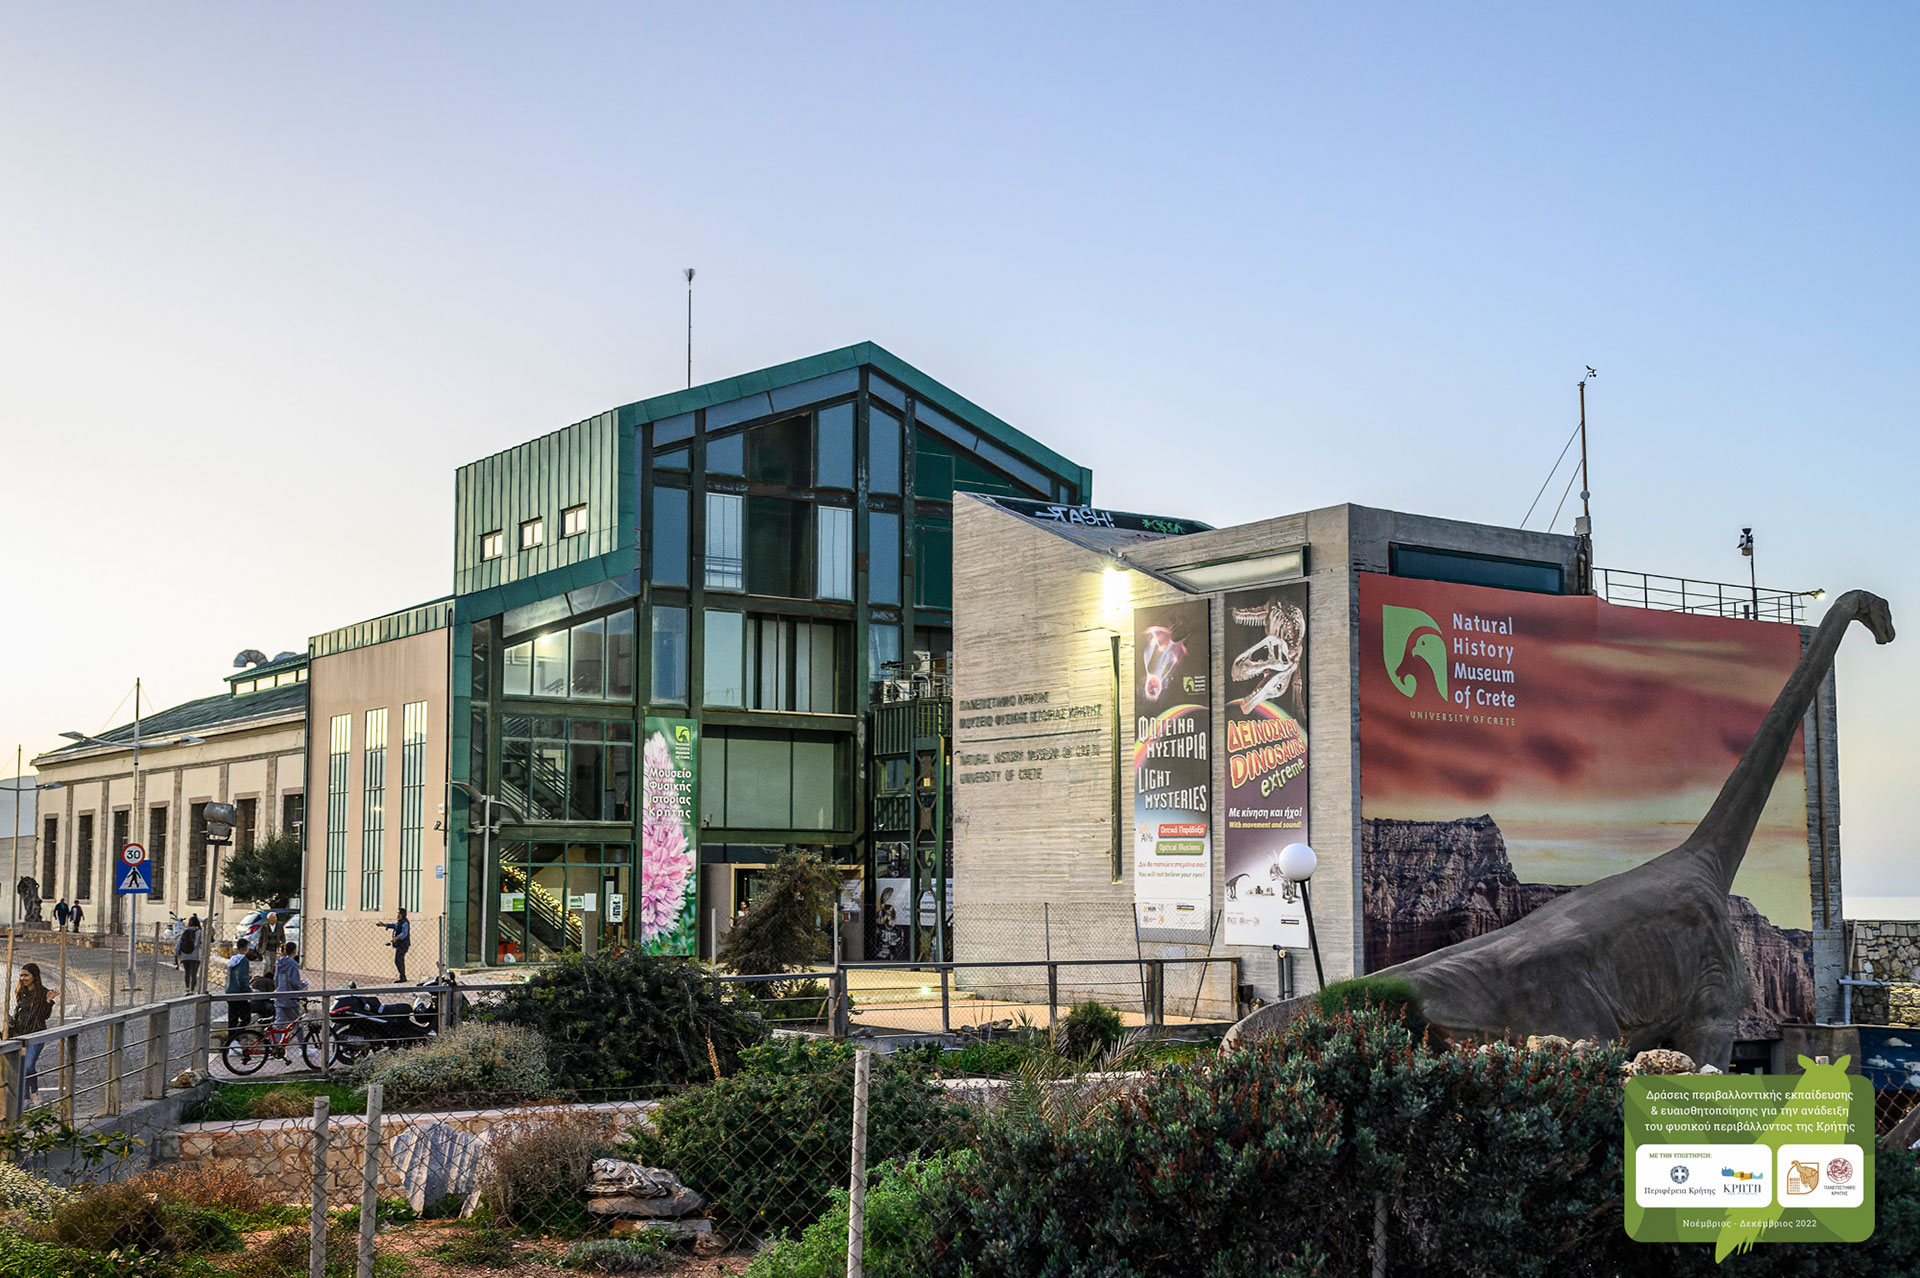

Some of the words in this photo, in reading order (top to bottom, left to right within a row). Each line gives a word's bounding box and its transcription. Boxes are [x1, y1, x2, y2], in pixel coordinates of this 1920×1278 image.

[1453, 613, 1513, 635] Natural
[1453, 637, 1514, 664] History
[1454, 662, 1515, 683] Museum
[1455, 685, 1471, 710] of
[1476, 689, 1516, 708] Crete
[1409, 710, 1471, 723] UNIVERSITY
[1473, 715, 1485, 724] OF
[1487, 716, 1516, 726] CRETE
[1146, 731, 1207, 761] ΜΥΣΤΗΡΙΑ
[650, 767, 692, 779] Μουσείο
[1230, 738, 1306, 789] DINOSAURS
[649, 780, 692, 793] Φυσικής
[1138, 766, 1172, 794] LIGHT
[1261, 758, 1306, 798] extreme
[1145, 784, 1207, 812] MYSTERIES
[649, 806, 692, 819] Κρήτης
[1228, 807, 1240, 818] Με
[1241, 807, 1269, 820] κίνηση
[1270, 809, 1283, 817] και
[1284, 806, 1303, 820] ήχο!
[126, 850, 141, 860] 30
